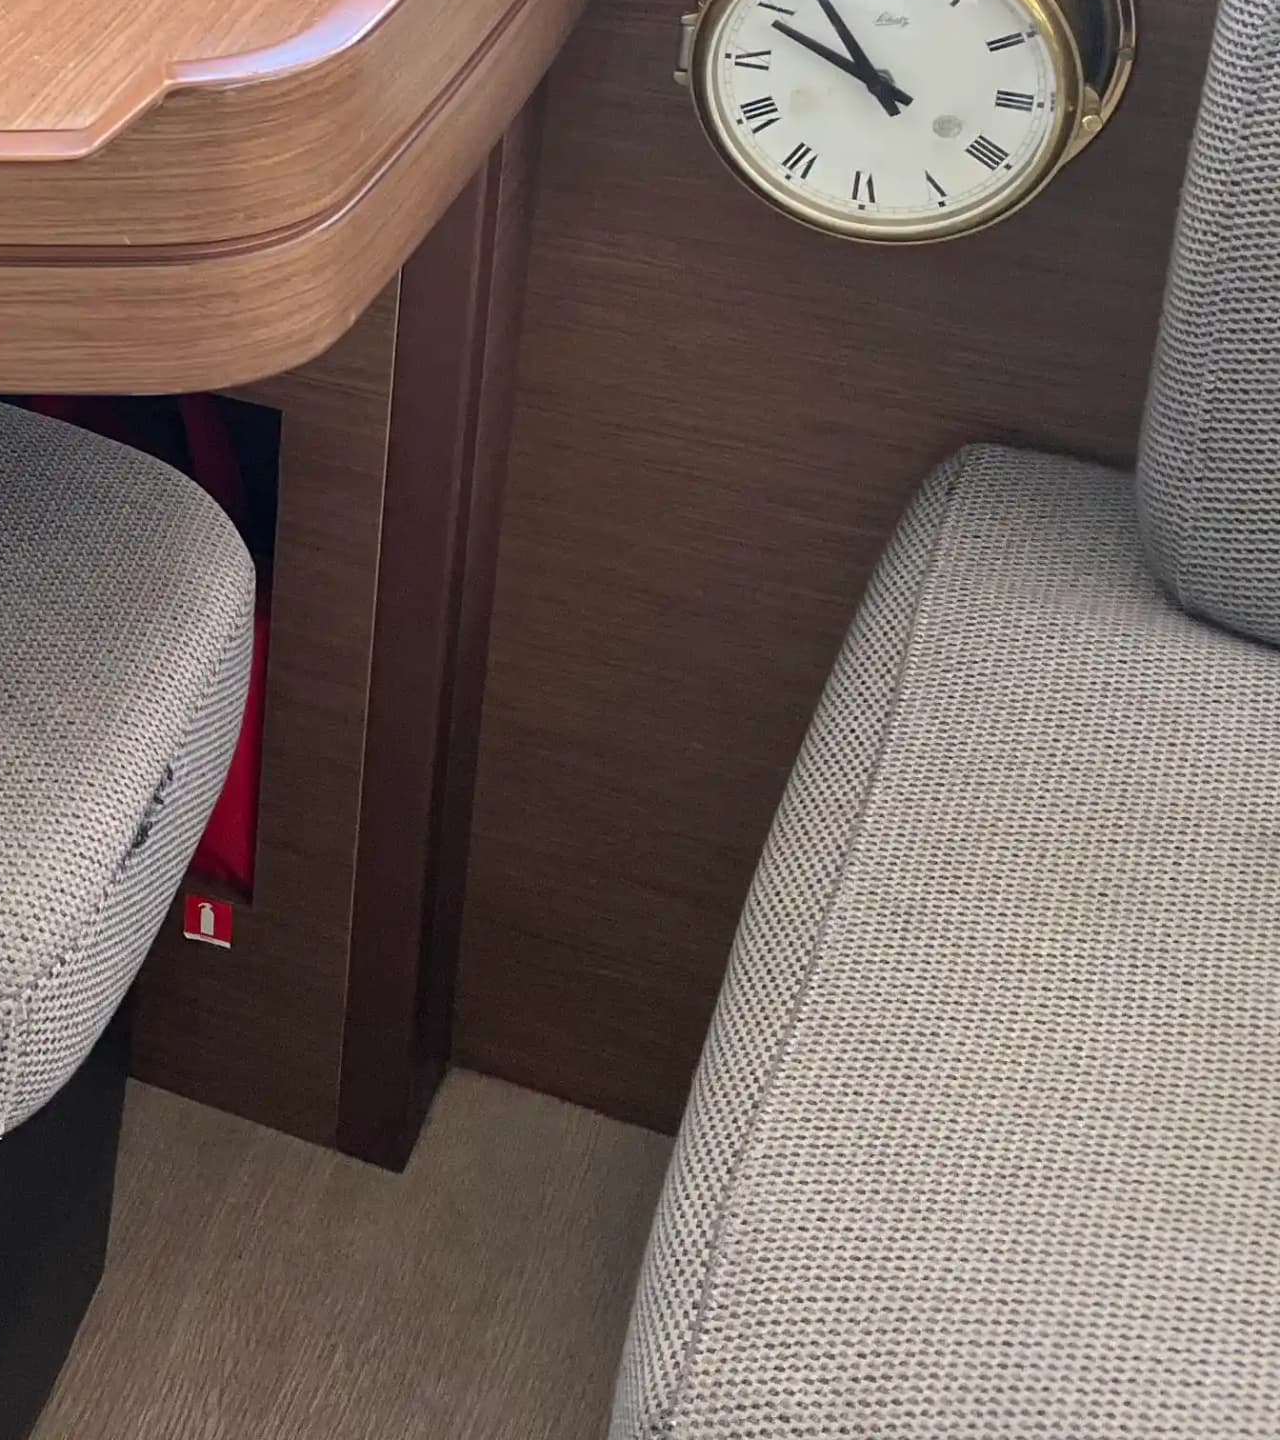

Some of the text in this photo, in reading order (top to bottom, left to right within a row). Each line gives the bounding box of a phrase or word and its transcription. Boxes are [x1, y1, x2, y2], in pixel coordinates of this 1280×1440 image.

[734, 48, 772, 71] IX
[739, 95, 781, 136] VIII
[994, 88, 1036, 113] III
[781, 141, 819, 180] VII
[965, 134, 1011, 173] IIII
[850, 169, 877, 205] VI
